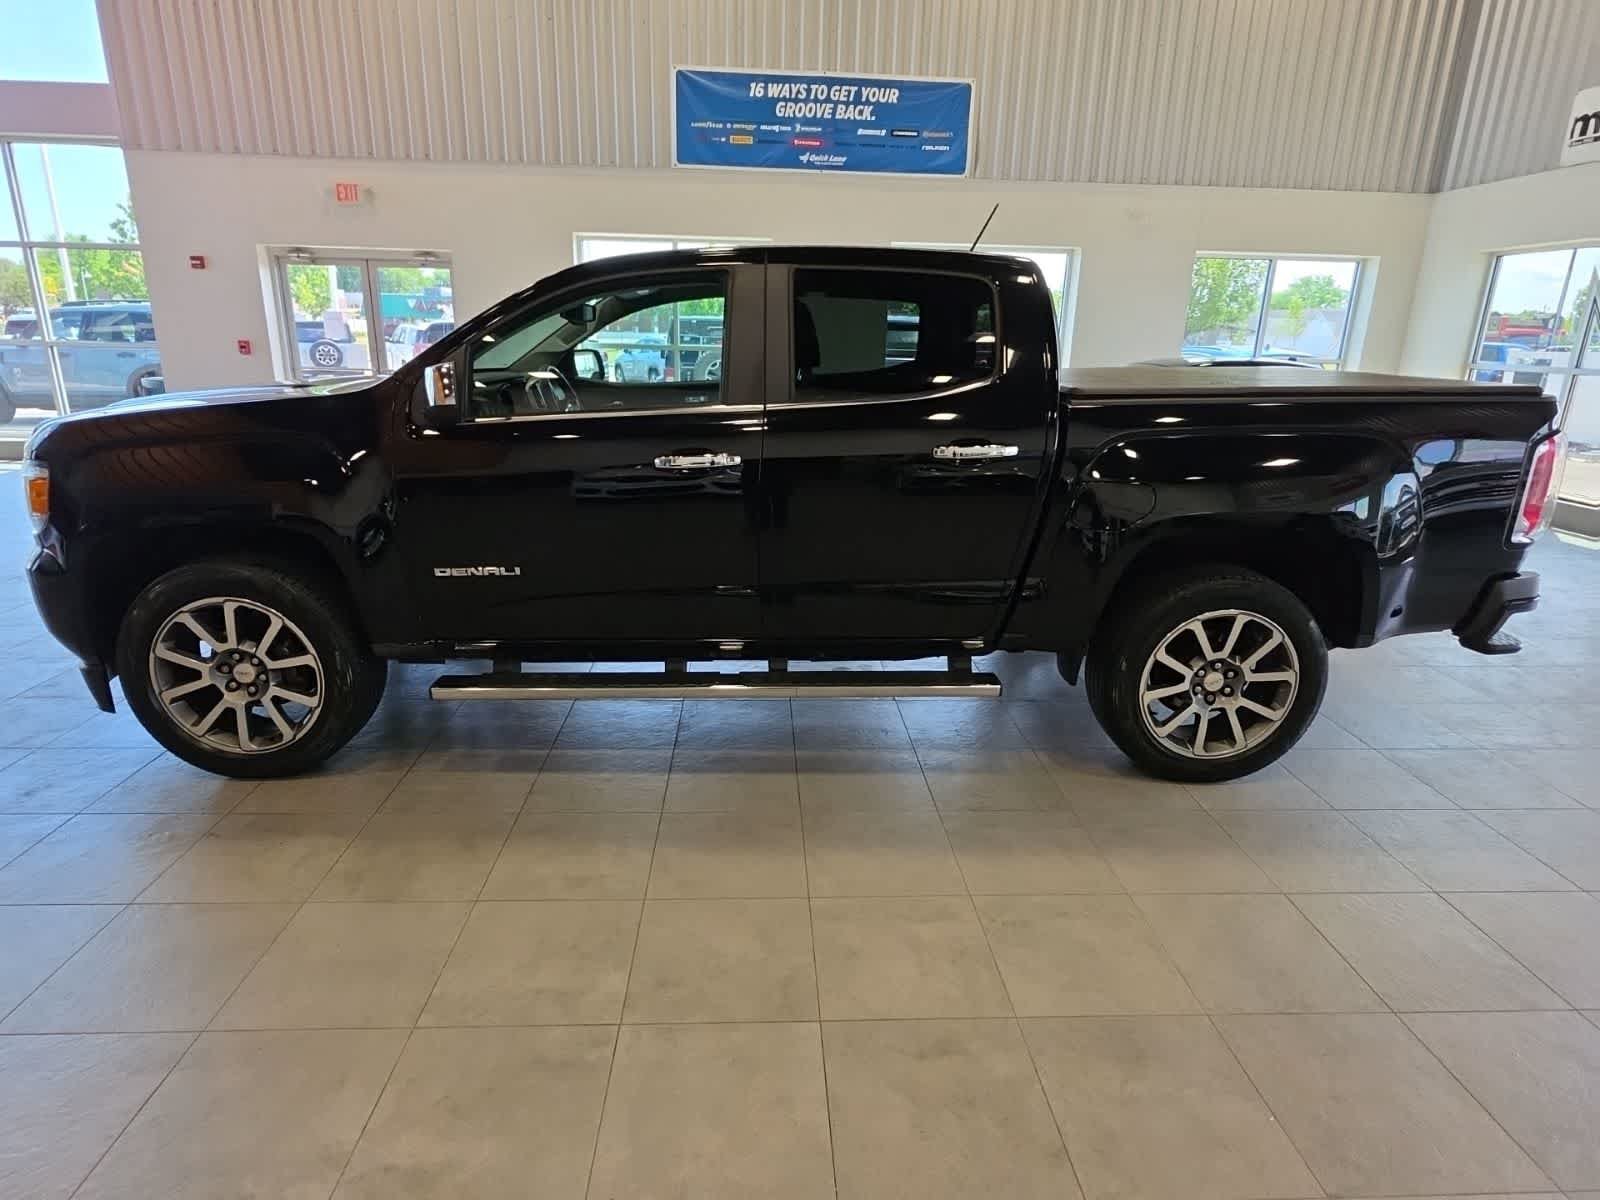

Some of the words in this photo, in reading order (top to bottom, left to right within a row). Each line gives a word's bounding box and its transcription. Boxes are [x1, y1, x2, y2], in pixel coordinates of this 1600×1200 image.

[749, 81, 765, 98] 16
[767, 82, 808, 100] WAYS
[809, 84, 828, 100] TO
[830, 85, 858, 101] GET
[861, 86, 900, 104] YOUR
[775, 102, 834, 119] GROOVE
[835, 104, 876, 121] BACK.
[336, 183, 360, 201] EXIT
[433, 566, 521, 577] DENALI
